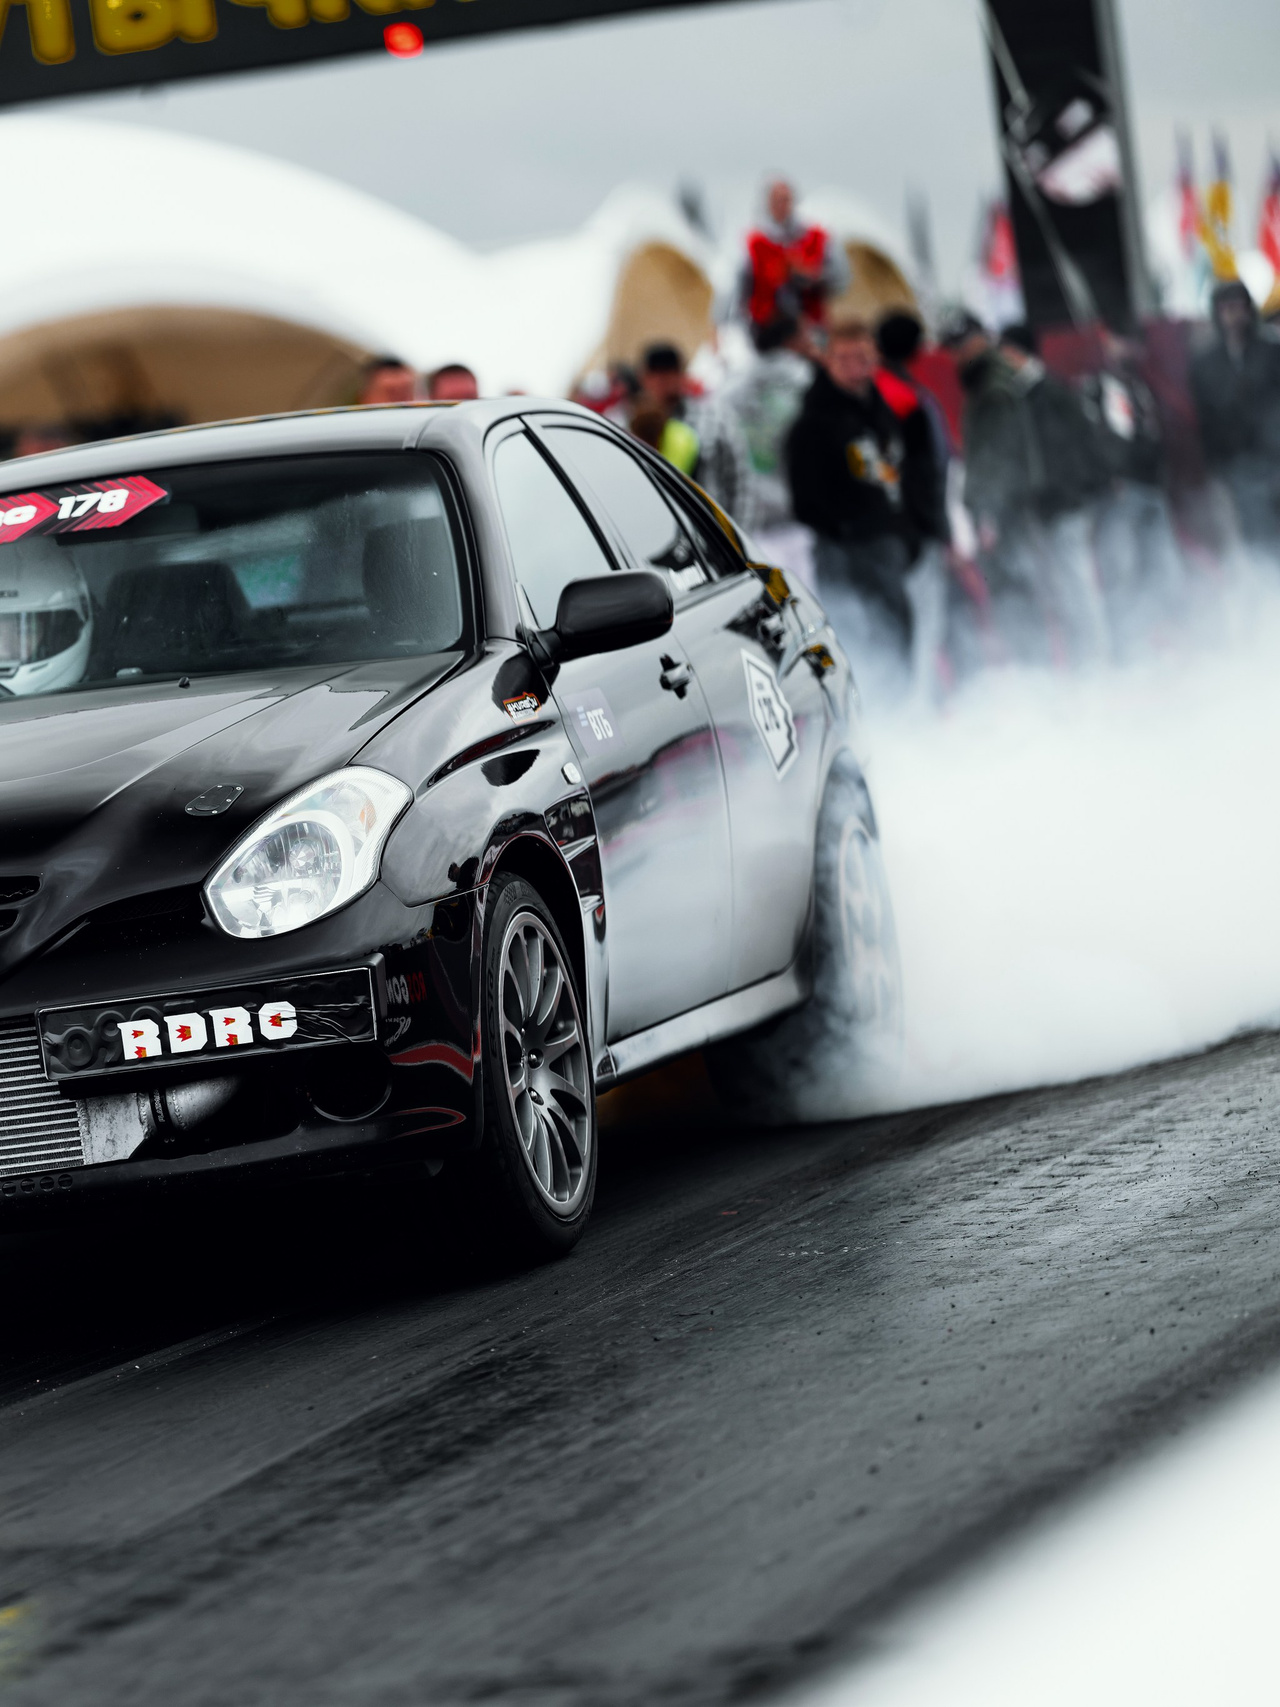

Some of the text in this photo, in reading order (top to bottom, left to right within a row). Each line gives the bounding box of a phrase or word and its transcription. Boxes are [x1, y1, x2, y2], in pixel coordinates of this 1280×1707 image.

[57, 489, 129, 519] 178
[586, 708, 614, 741] ВТБ
[116, 1001, 298, 1061] RDRC
